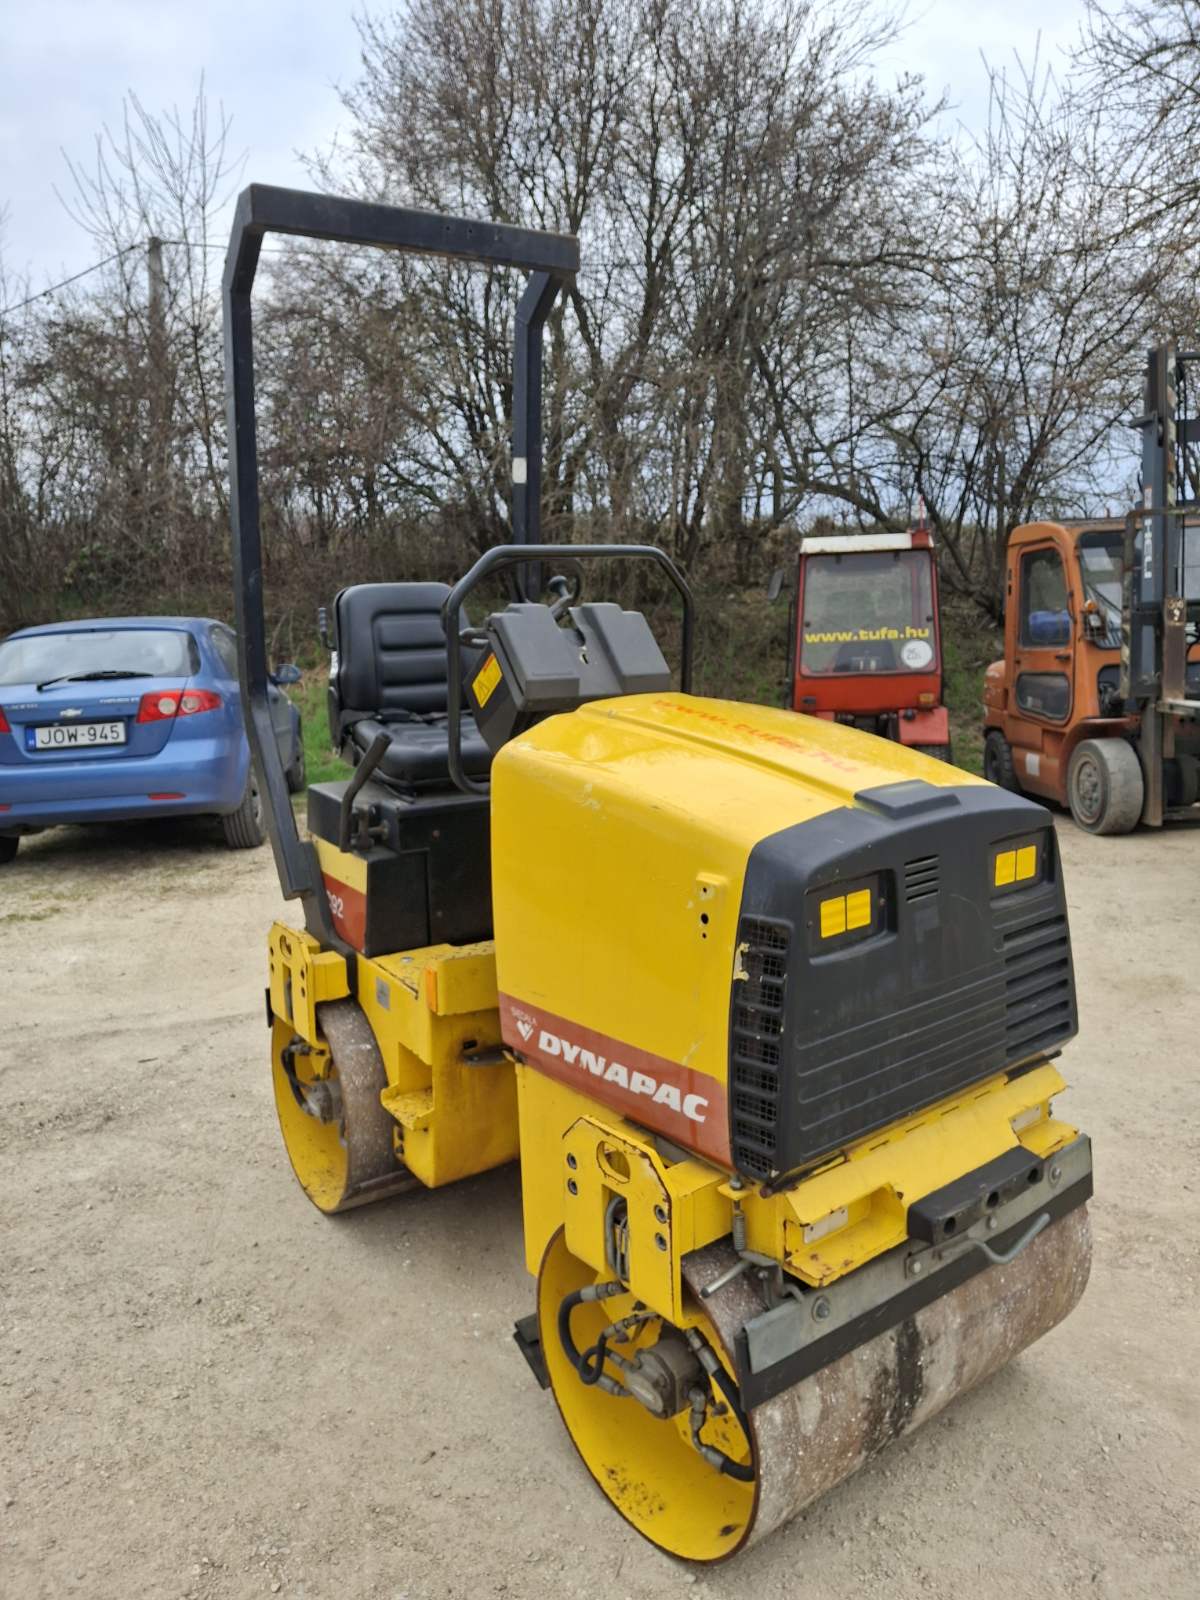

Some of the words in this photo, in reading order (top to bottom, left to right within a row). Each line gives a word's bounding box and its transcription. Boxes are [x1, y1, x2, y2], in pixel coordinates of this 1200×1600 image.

[805, 626, 929, 643] www.tufa.hu
[41, 725, 120, 745] JOW-945
[539, 1030, 709, 1123] DYNAPAC
